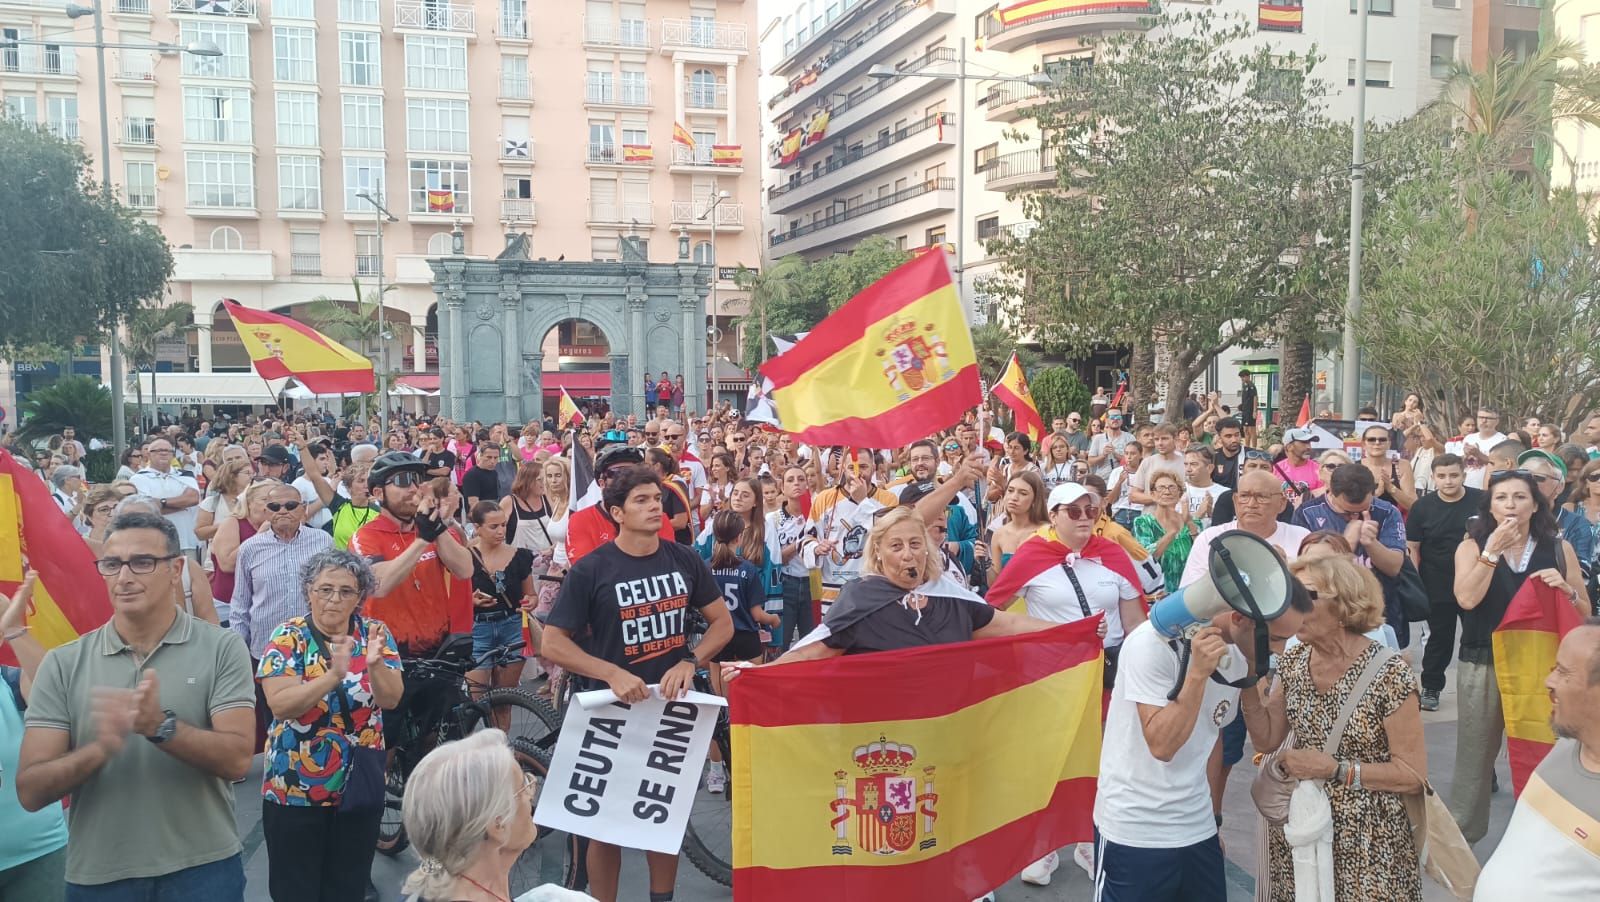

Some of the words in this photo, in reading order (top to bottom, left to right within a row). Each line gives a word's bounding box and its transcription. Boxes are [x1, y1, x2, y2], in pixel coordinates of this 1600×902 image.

[614, 571, 689, 608] CEUTA
[724, 582, 739, 612] 5
[620, 608, 637, 620] NO
[638, 604, 653, 617] SE
[655, 597, 689, 614] VENDE
[624, 645, 640, 656] SE
[563, 717, 627, 817] CEUTA
[632, 779, 676, 824] SE
